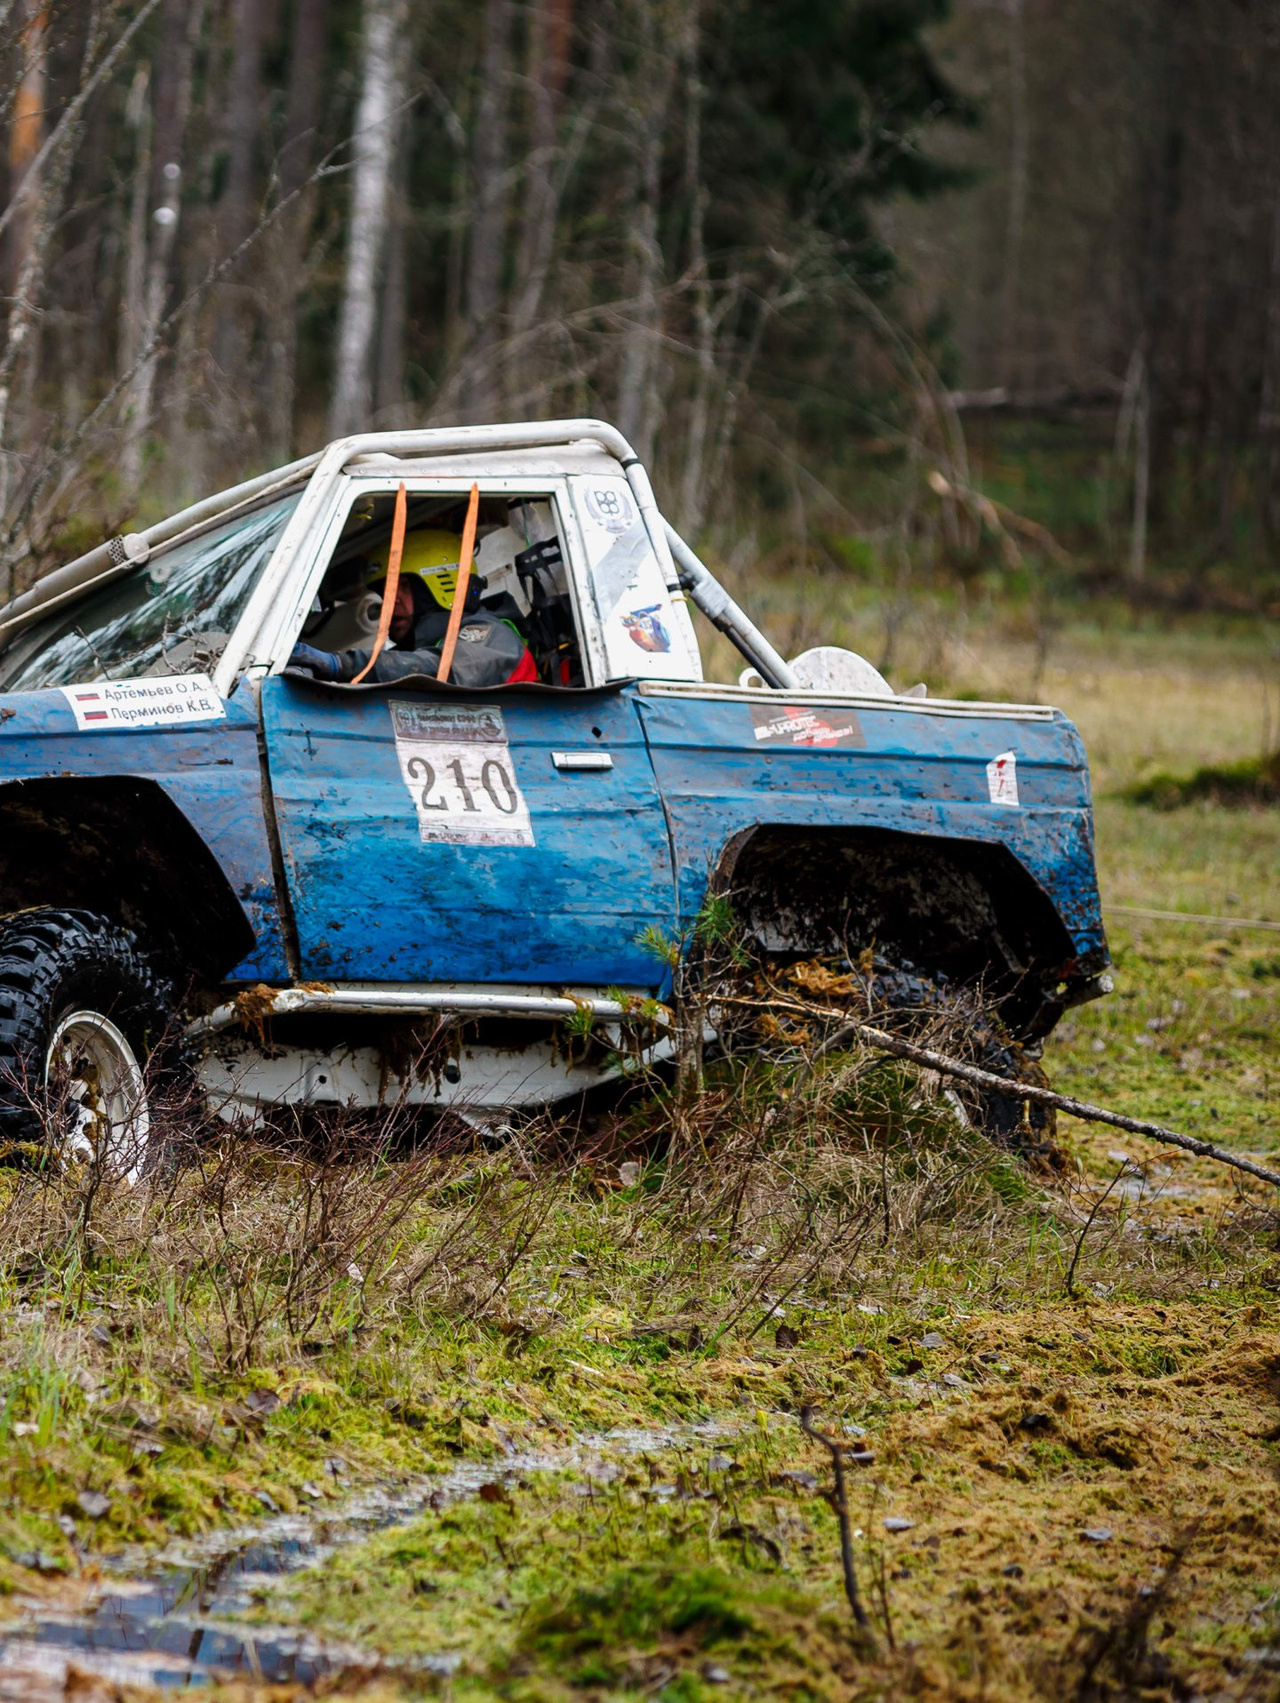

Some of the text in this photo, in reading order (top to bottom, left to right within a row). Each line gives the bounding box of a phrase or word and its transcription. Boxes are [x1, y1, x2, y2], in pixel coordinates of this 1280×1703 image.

[104, 686, 174, 702] Артемьев
[110, 704, 184, 721] Перминов
[407, 757, 518, 815] 210
